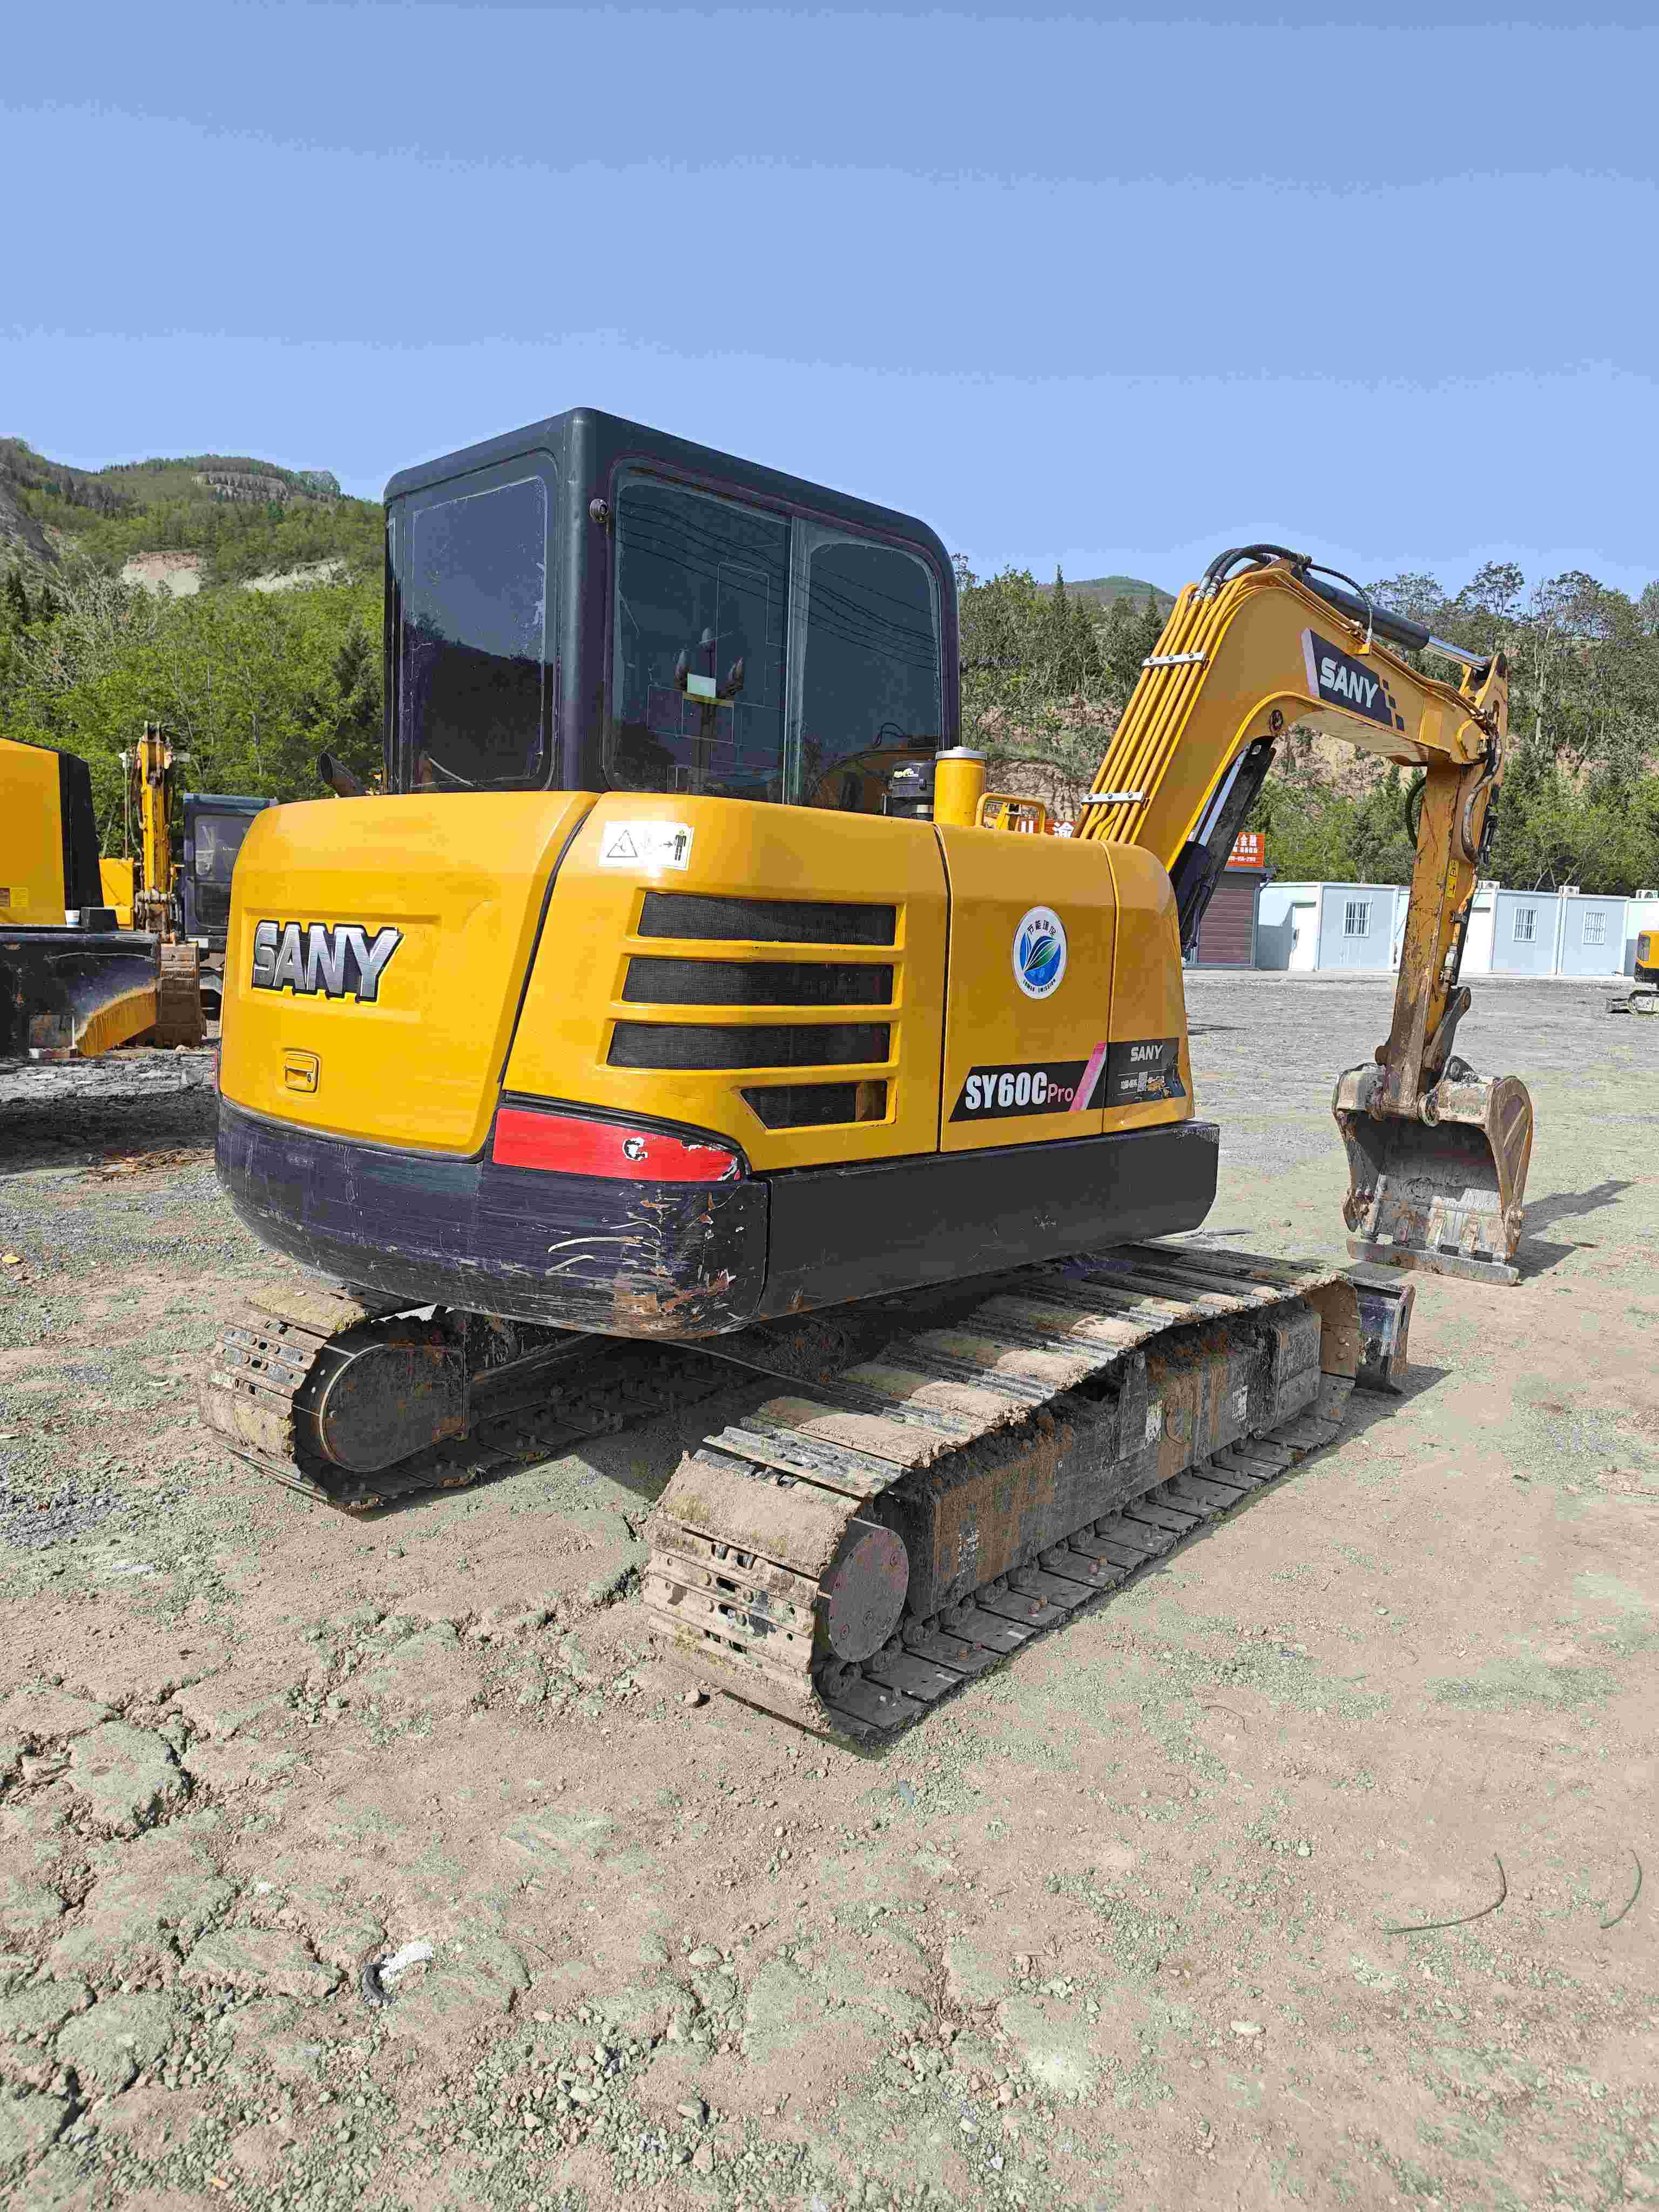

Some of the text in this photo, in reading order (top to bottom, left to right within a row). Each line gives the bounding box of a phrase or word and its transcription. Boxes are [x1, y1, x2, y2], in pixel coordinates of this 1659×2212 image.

[1320, 657, 1379, 708] SANY
[252, 920, 401, 1001] SANY
[1130, 1045, 1163, 1062] SANY
